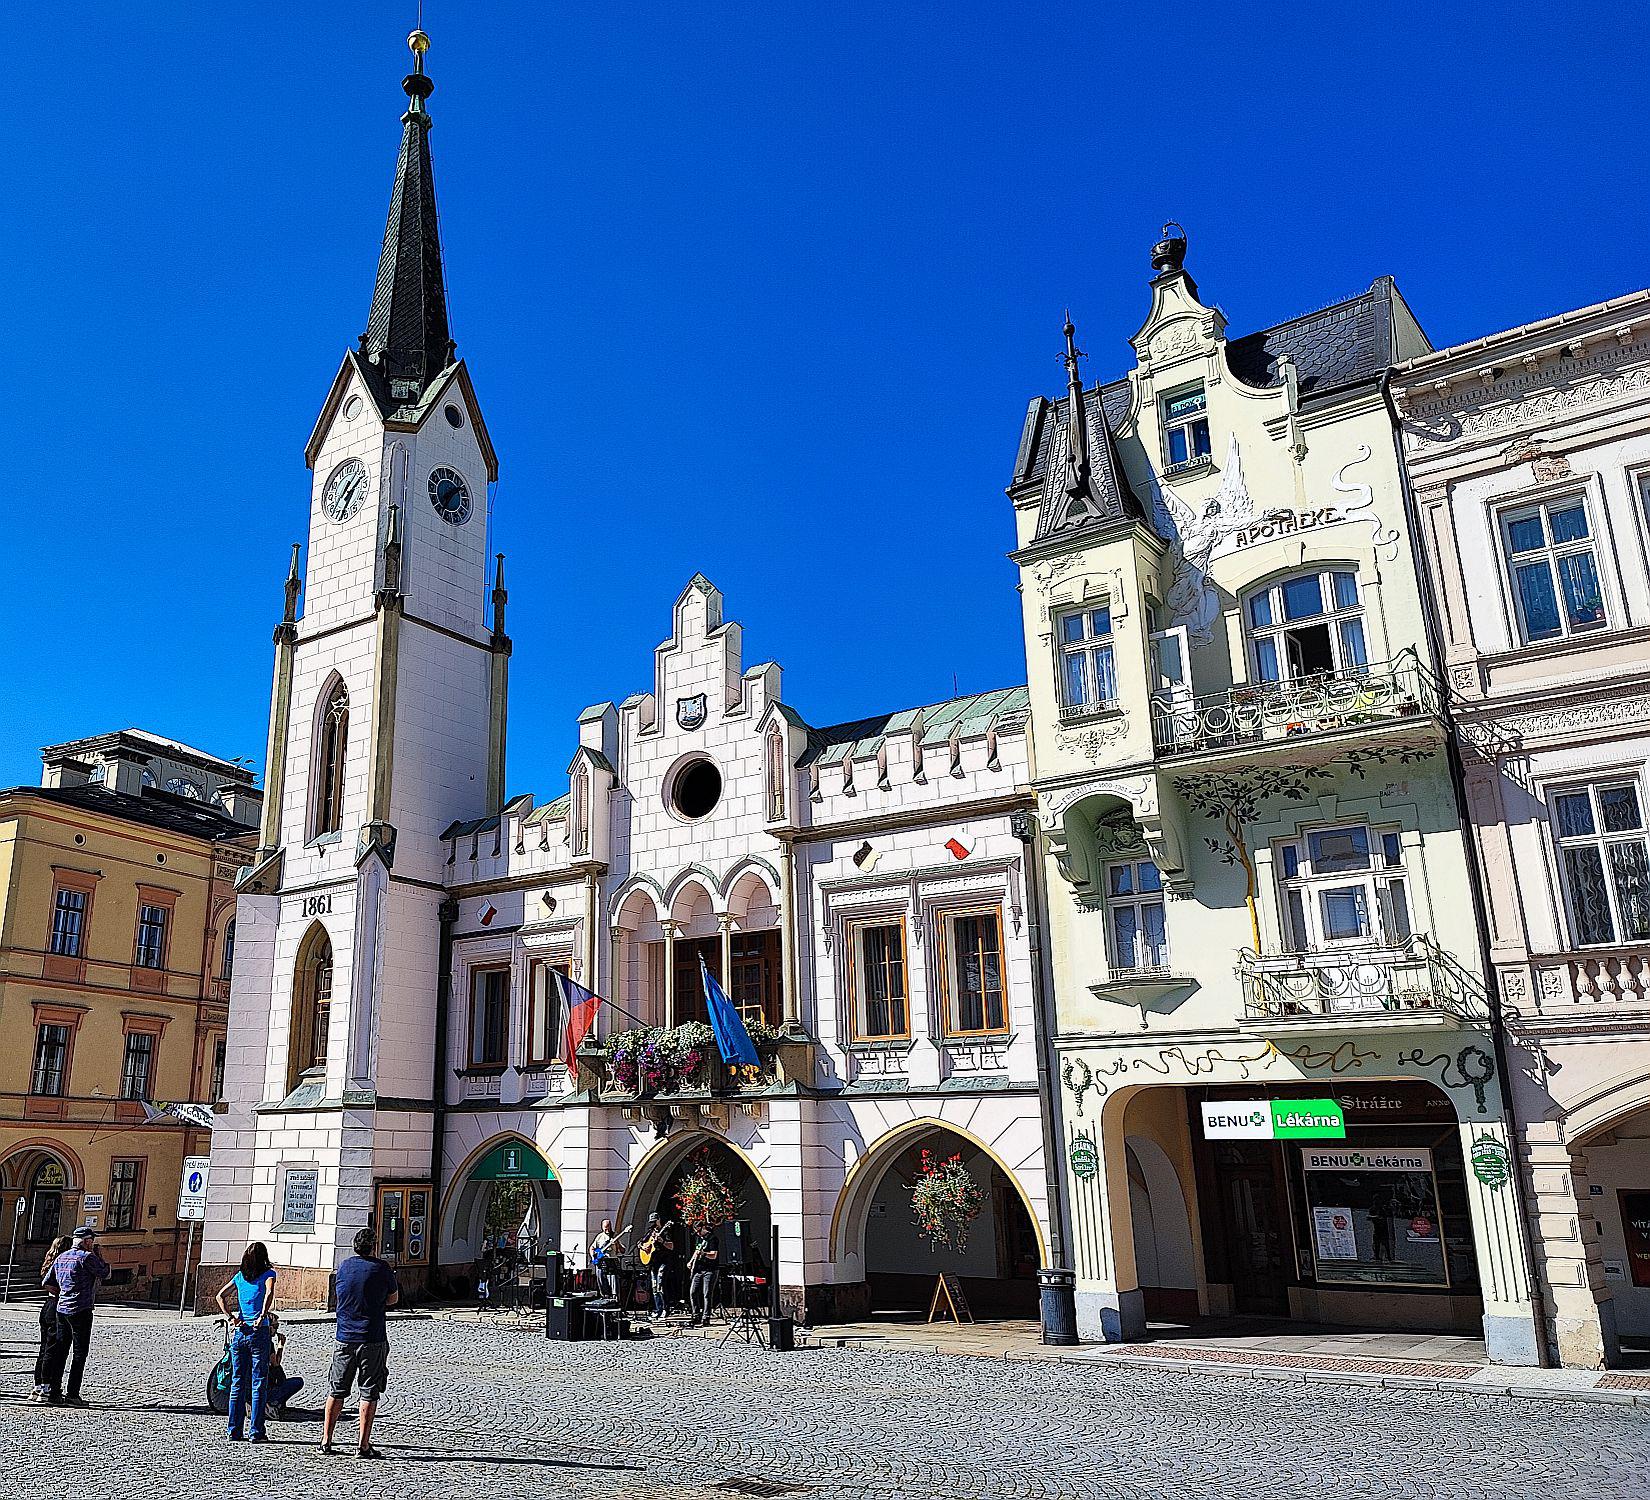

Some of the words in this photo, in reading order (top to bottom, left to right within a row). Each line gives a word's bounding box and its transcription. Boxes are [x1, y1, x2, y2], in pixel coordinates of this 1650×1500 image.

[1236, 507, 1347, 548] APOTHEKE
[301, 893, 333, 918] 1861
[1340, 1095, 1403, 1111] Strážce
[1207, 1115, 1249, 1128] BENU
[1276, 1112, 1341, 1128] Lékárna
[1310, 1154, 1350, 1167] BENU
[1366, 1153, 1423, 1168] Lékárna
